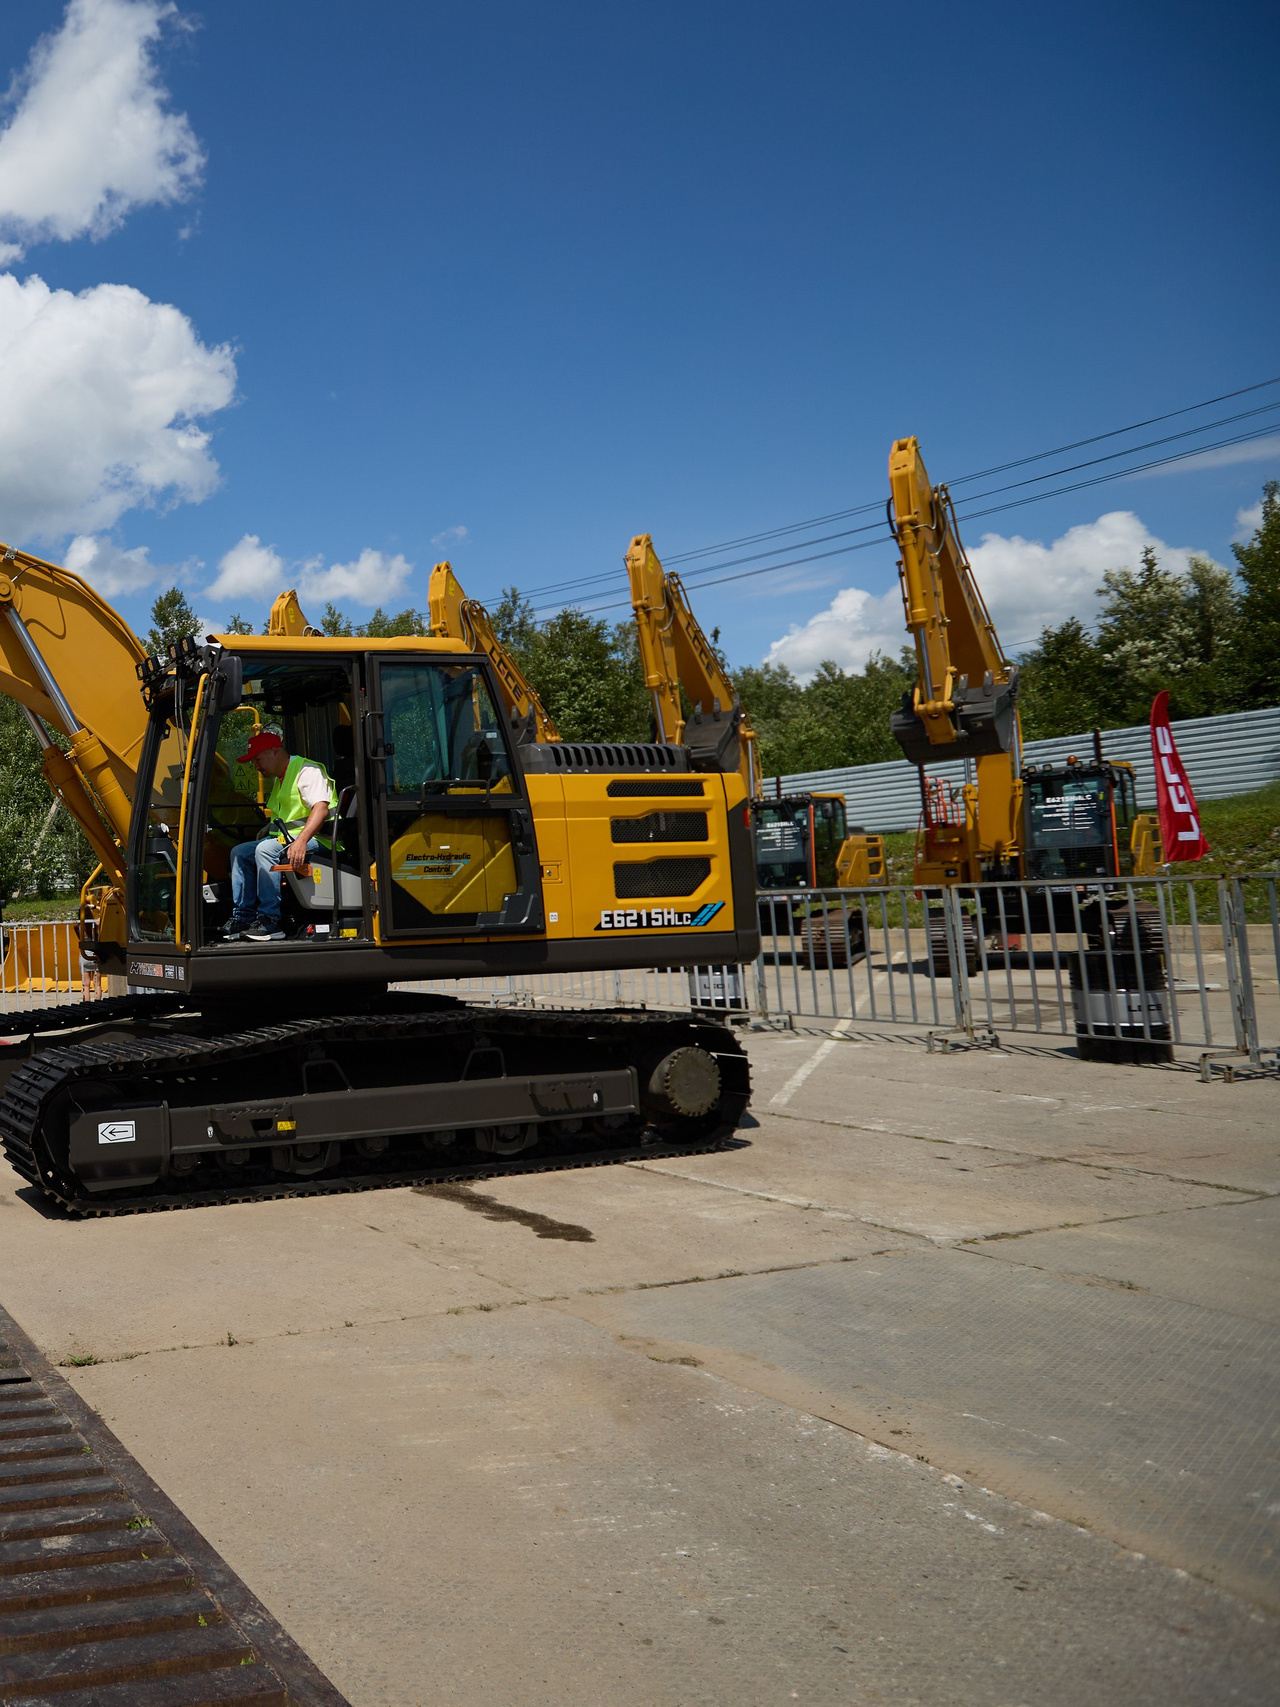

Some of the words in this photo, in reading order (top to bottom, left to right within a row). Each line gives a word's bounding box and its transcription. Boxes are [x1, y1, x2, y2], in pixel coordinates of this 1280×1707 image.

[489, 645, 523, 702] LGCE
[686, 621, 714, 679] LGCE
[1155, 726, 1200, 841] LGCE
[406, 853, 471, 861] Electro-Hydraulic
[600, 908, 692, 928] E6215HLC
